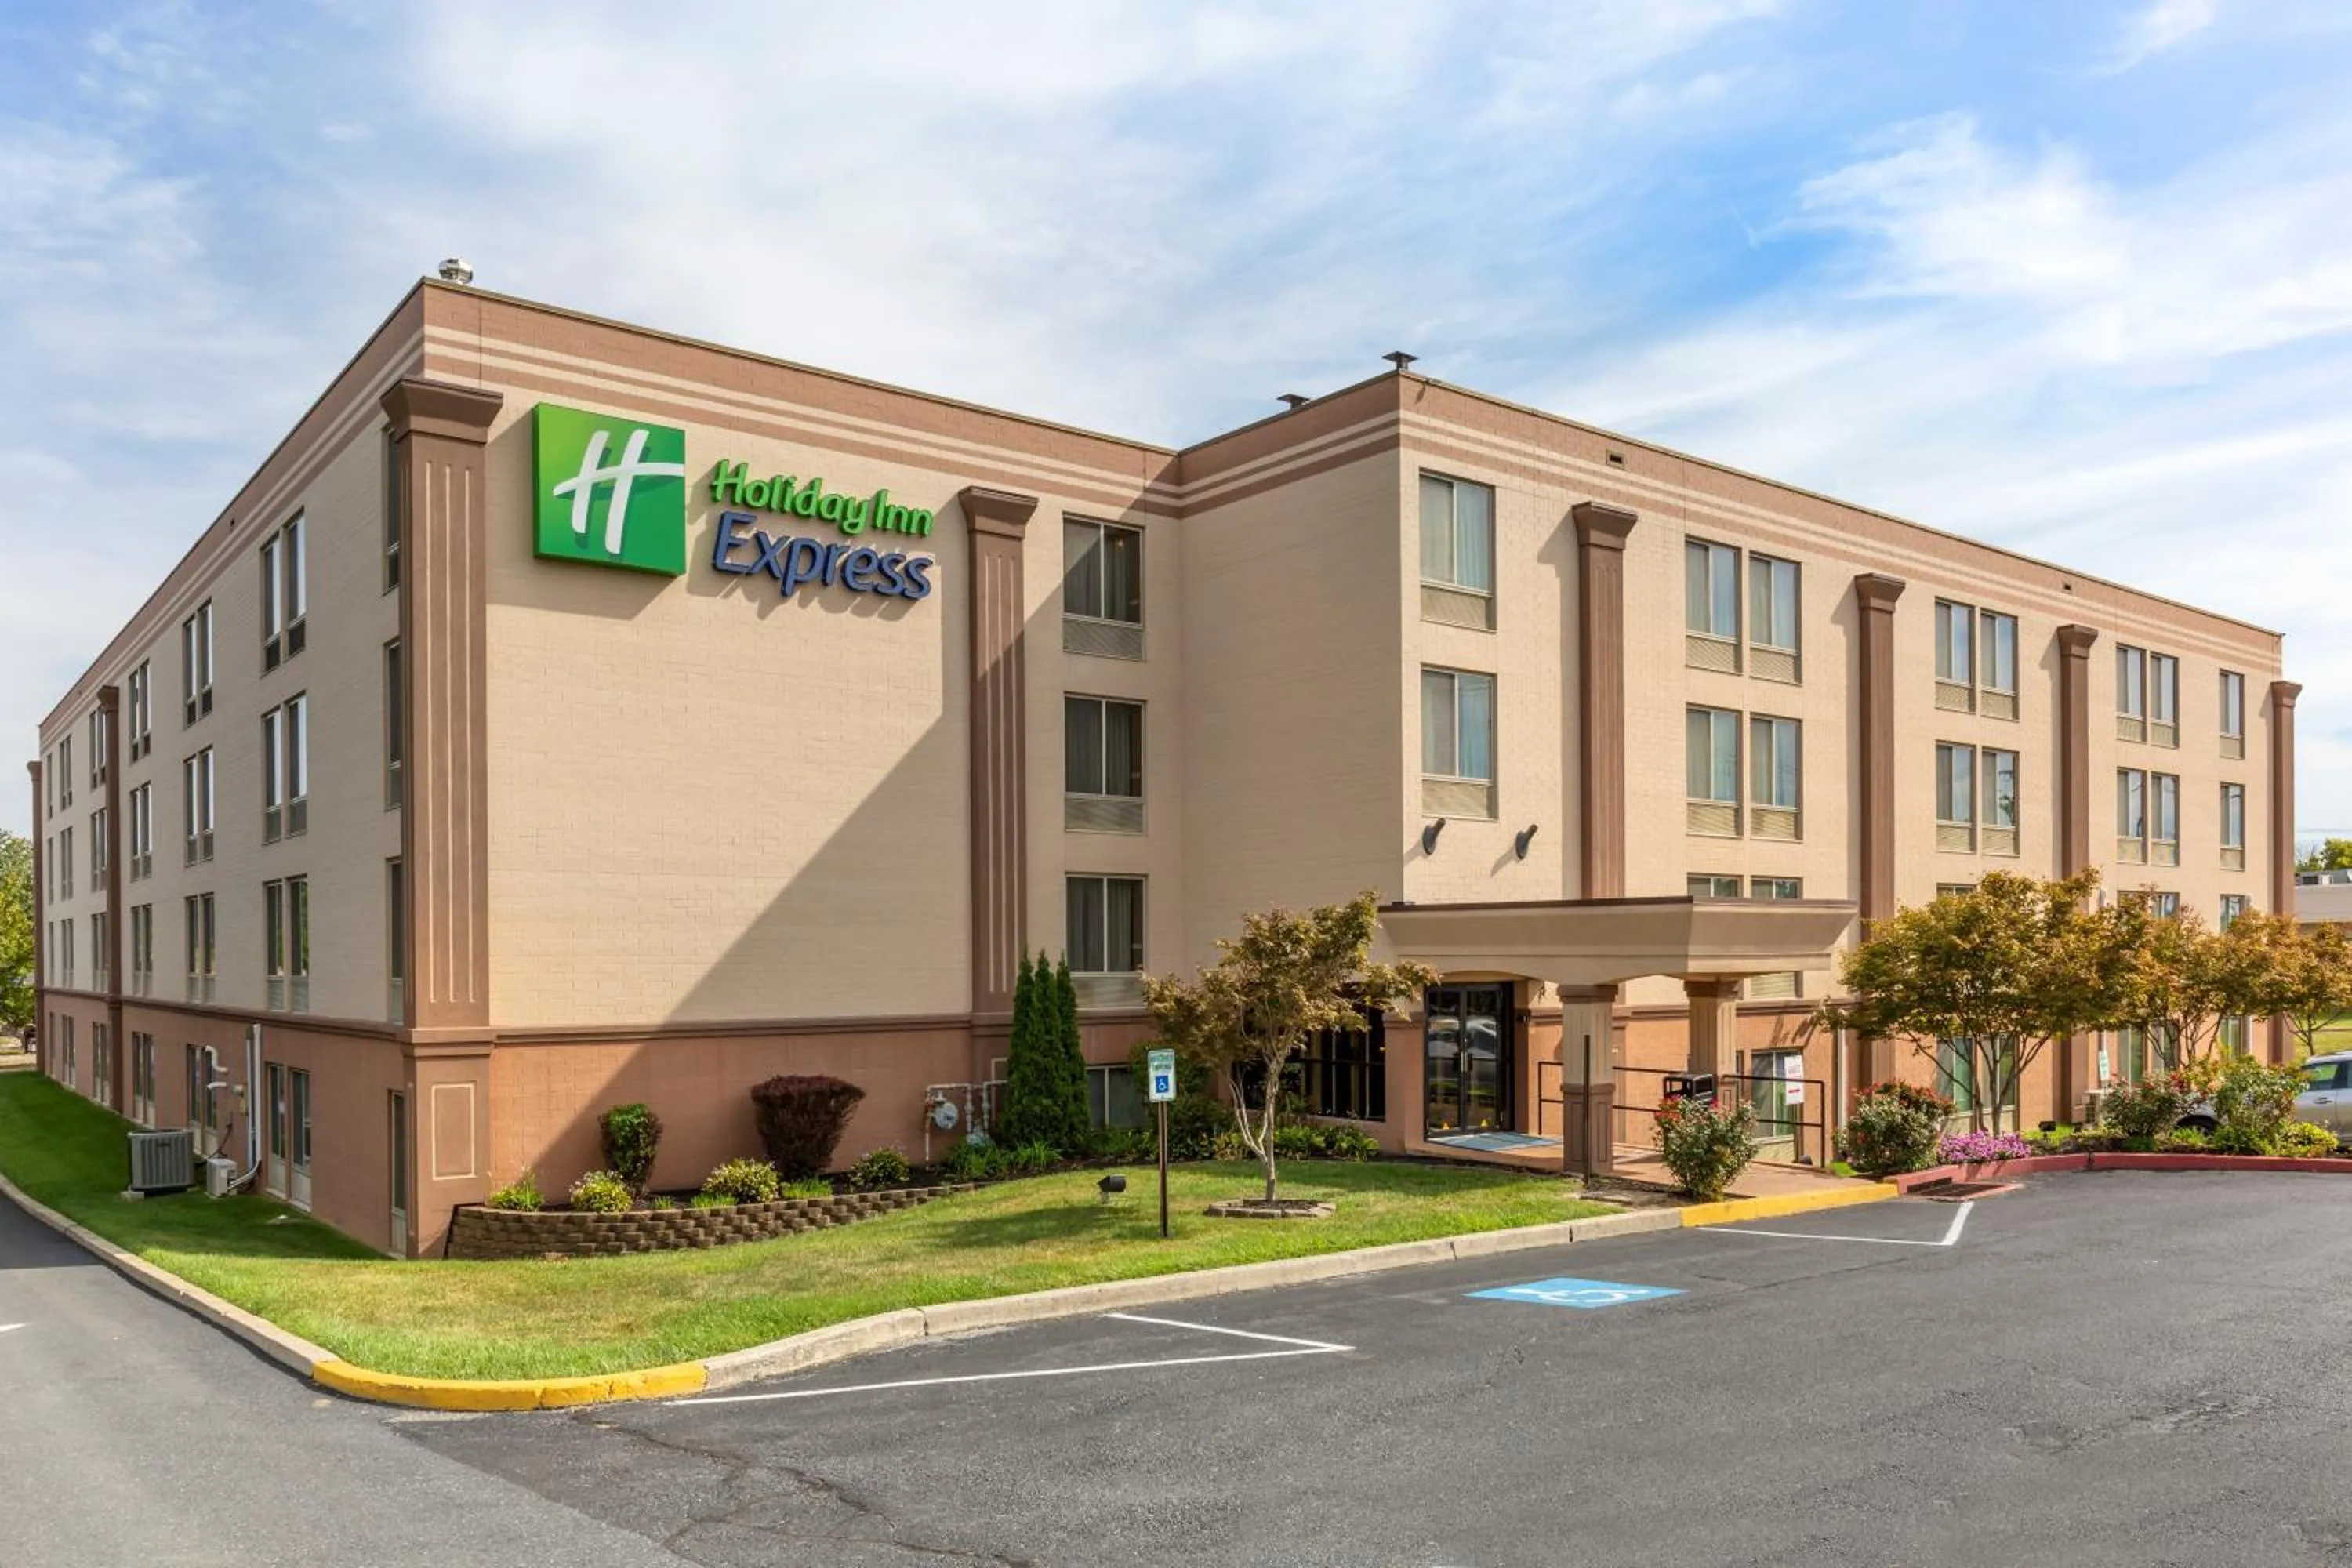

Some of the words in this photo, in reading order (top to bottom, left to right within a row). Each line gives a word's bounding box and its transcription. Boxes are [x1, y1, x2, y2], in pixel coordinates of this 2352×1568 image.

[711, 459, 869, 536] Holiday
[875, 489, 934, 538] Inn
[713, 511, 934, 601] Express
